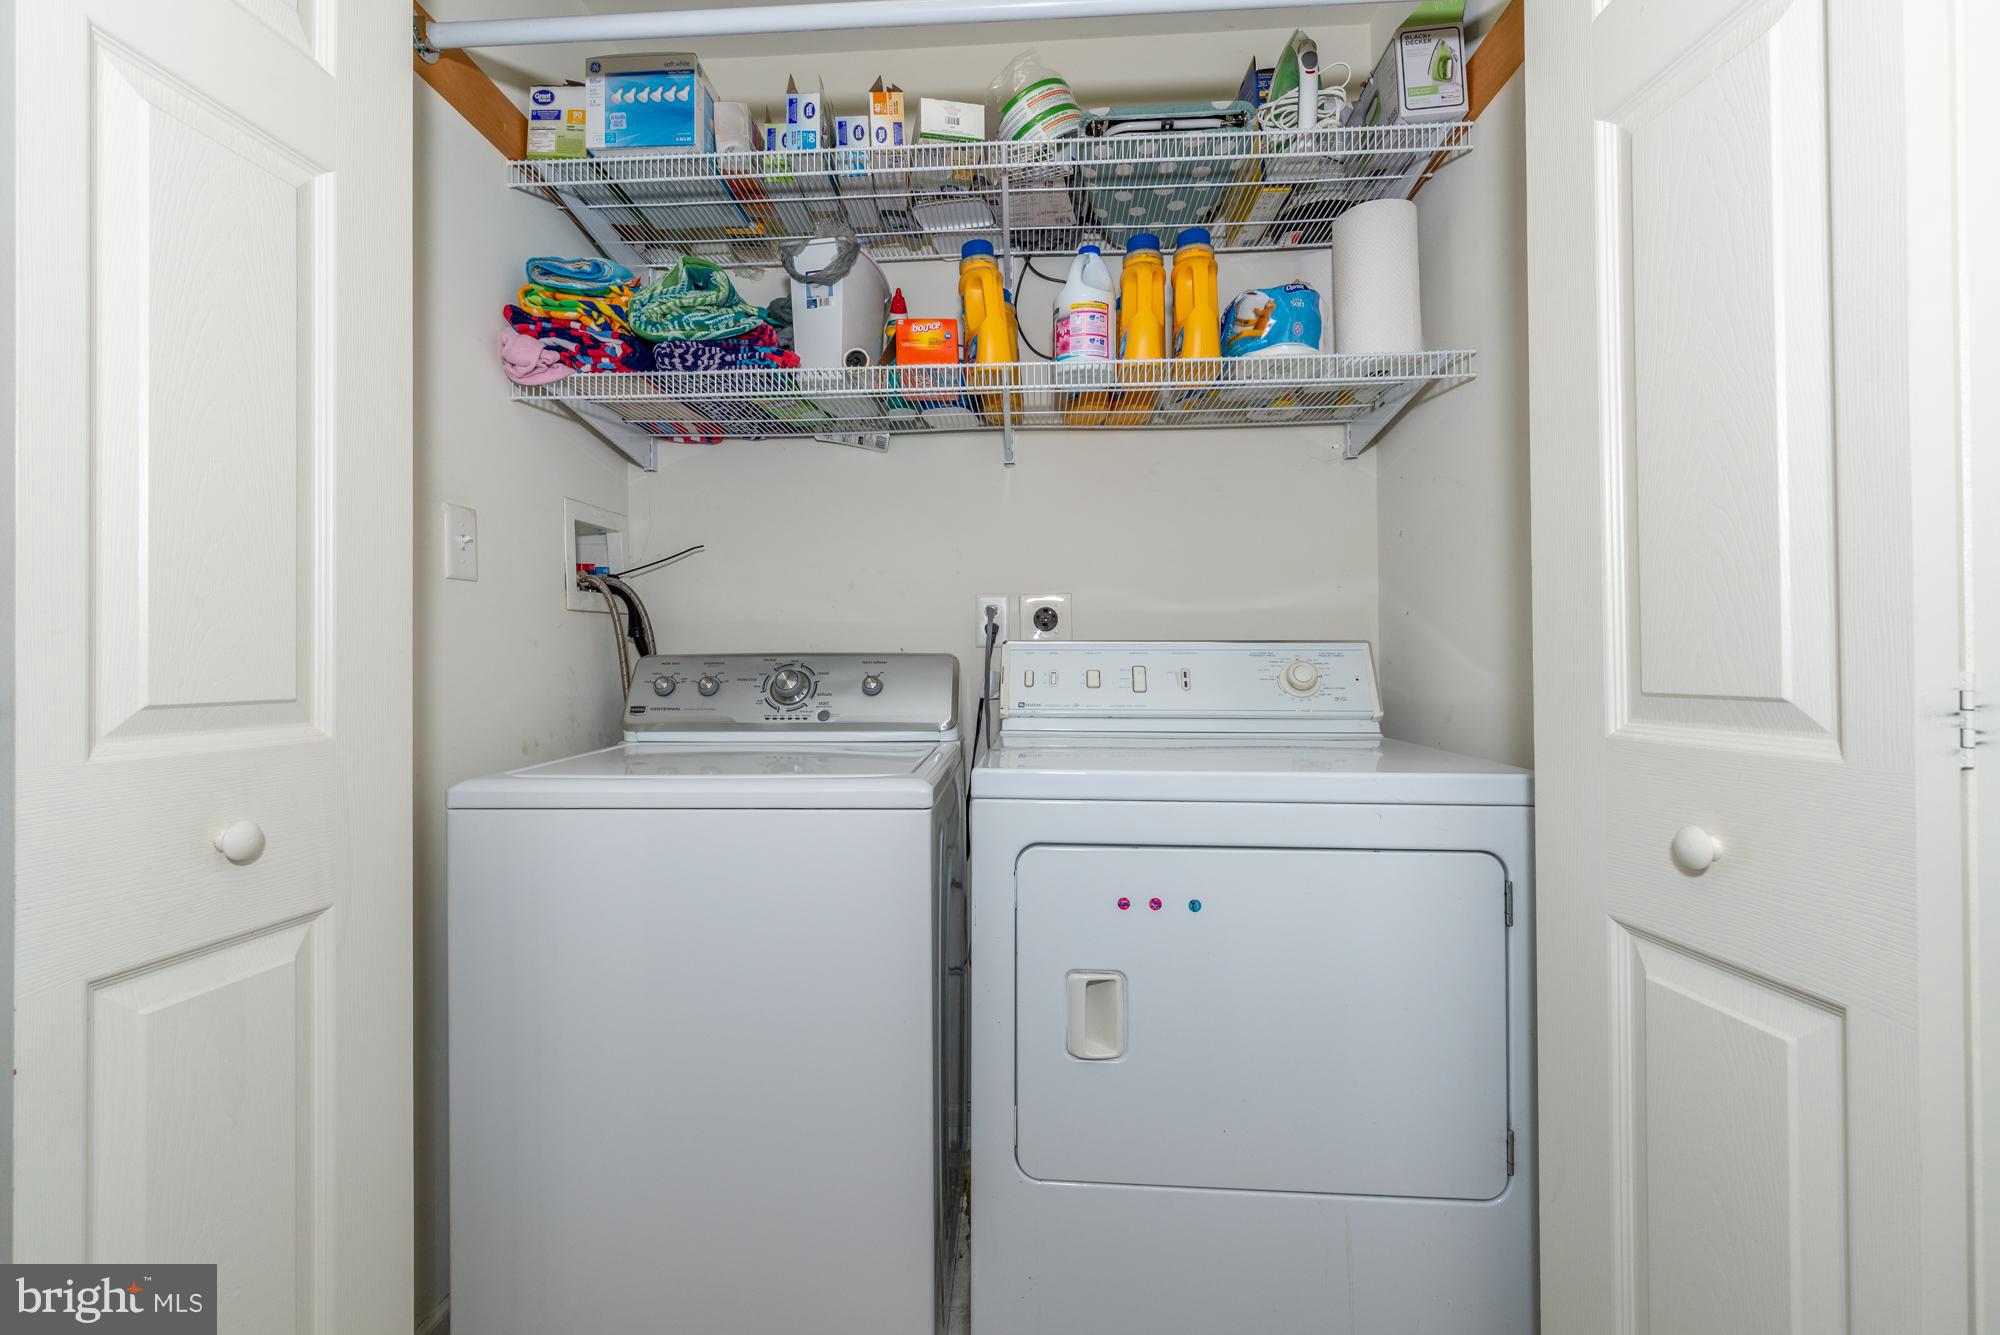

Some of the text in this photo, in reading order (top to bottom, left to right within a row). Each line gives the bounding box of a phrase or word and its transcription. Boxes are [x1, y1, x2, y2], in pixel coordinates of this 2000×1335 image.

[1405, 38, 1432, 46] DECKER
[874, 103, 881, 113] 40
[573, 111, 583, 119] 90
[808, 132, 816, 143] 60
[911, 321, 941, 333] bounce
